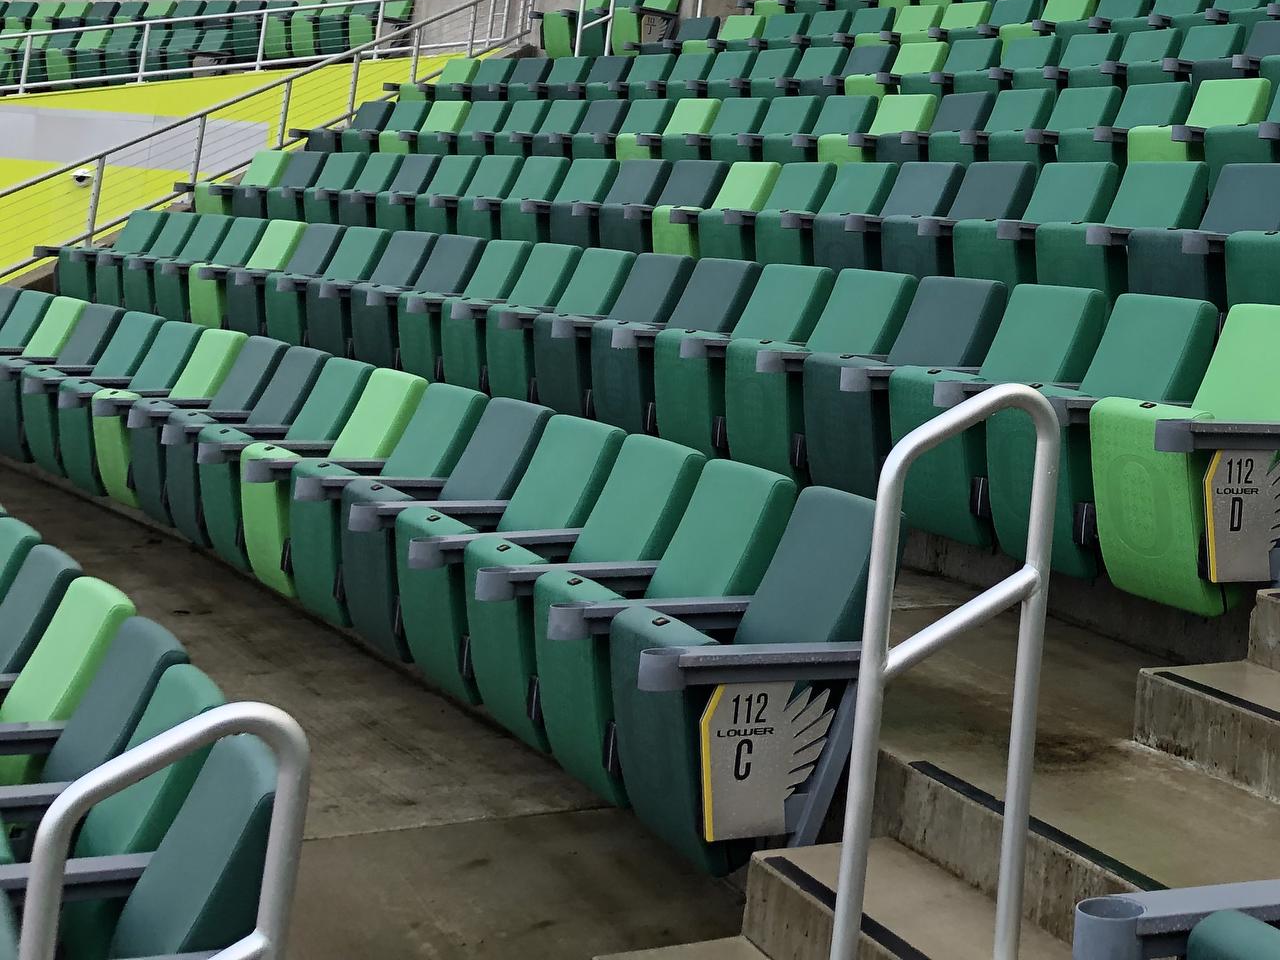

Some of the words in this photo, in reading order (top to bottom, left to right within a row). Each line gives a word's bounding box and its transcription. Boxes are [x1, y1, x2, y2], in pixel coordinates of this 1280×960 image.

[1227, 458, 1254, 484] 112
[1216, 487, 1259, 495] LOWER
[1229, 497, 1243, 532] D
[732, 692, 769, 725] 112
[716, 727, 775, 738] LOWER
[733, 739, 753, 781] C
